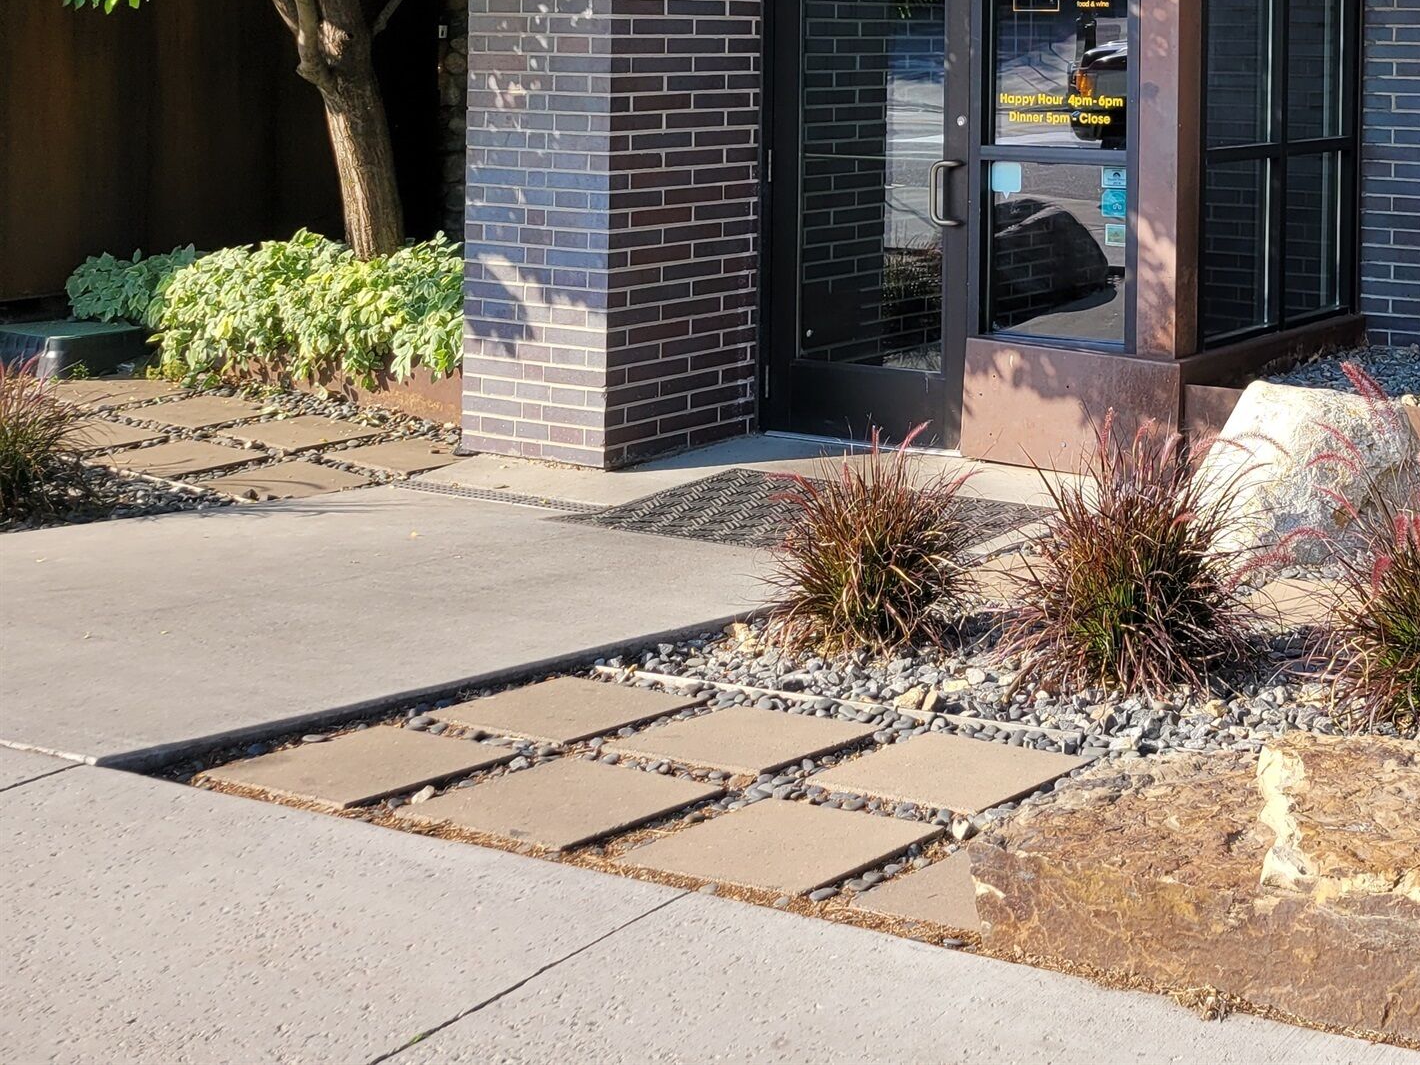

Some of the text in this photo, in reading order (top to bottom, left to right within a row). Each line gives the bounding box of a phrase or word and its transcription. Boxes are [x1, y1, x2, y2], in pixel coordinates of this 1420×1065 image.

[1076, 0, 1090, 8] food
[1096, 0, 1110, 8] wine
[1000, 93, 1036, 106] Happy
[1038, 93, 1064, 105] Hour
[1009, 111, 1043, 123] Dinner
[1046, 112, 1070, 125] 5pm
[1079, 113, 1111, 125] Close
